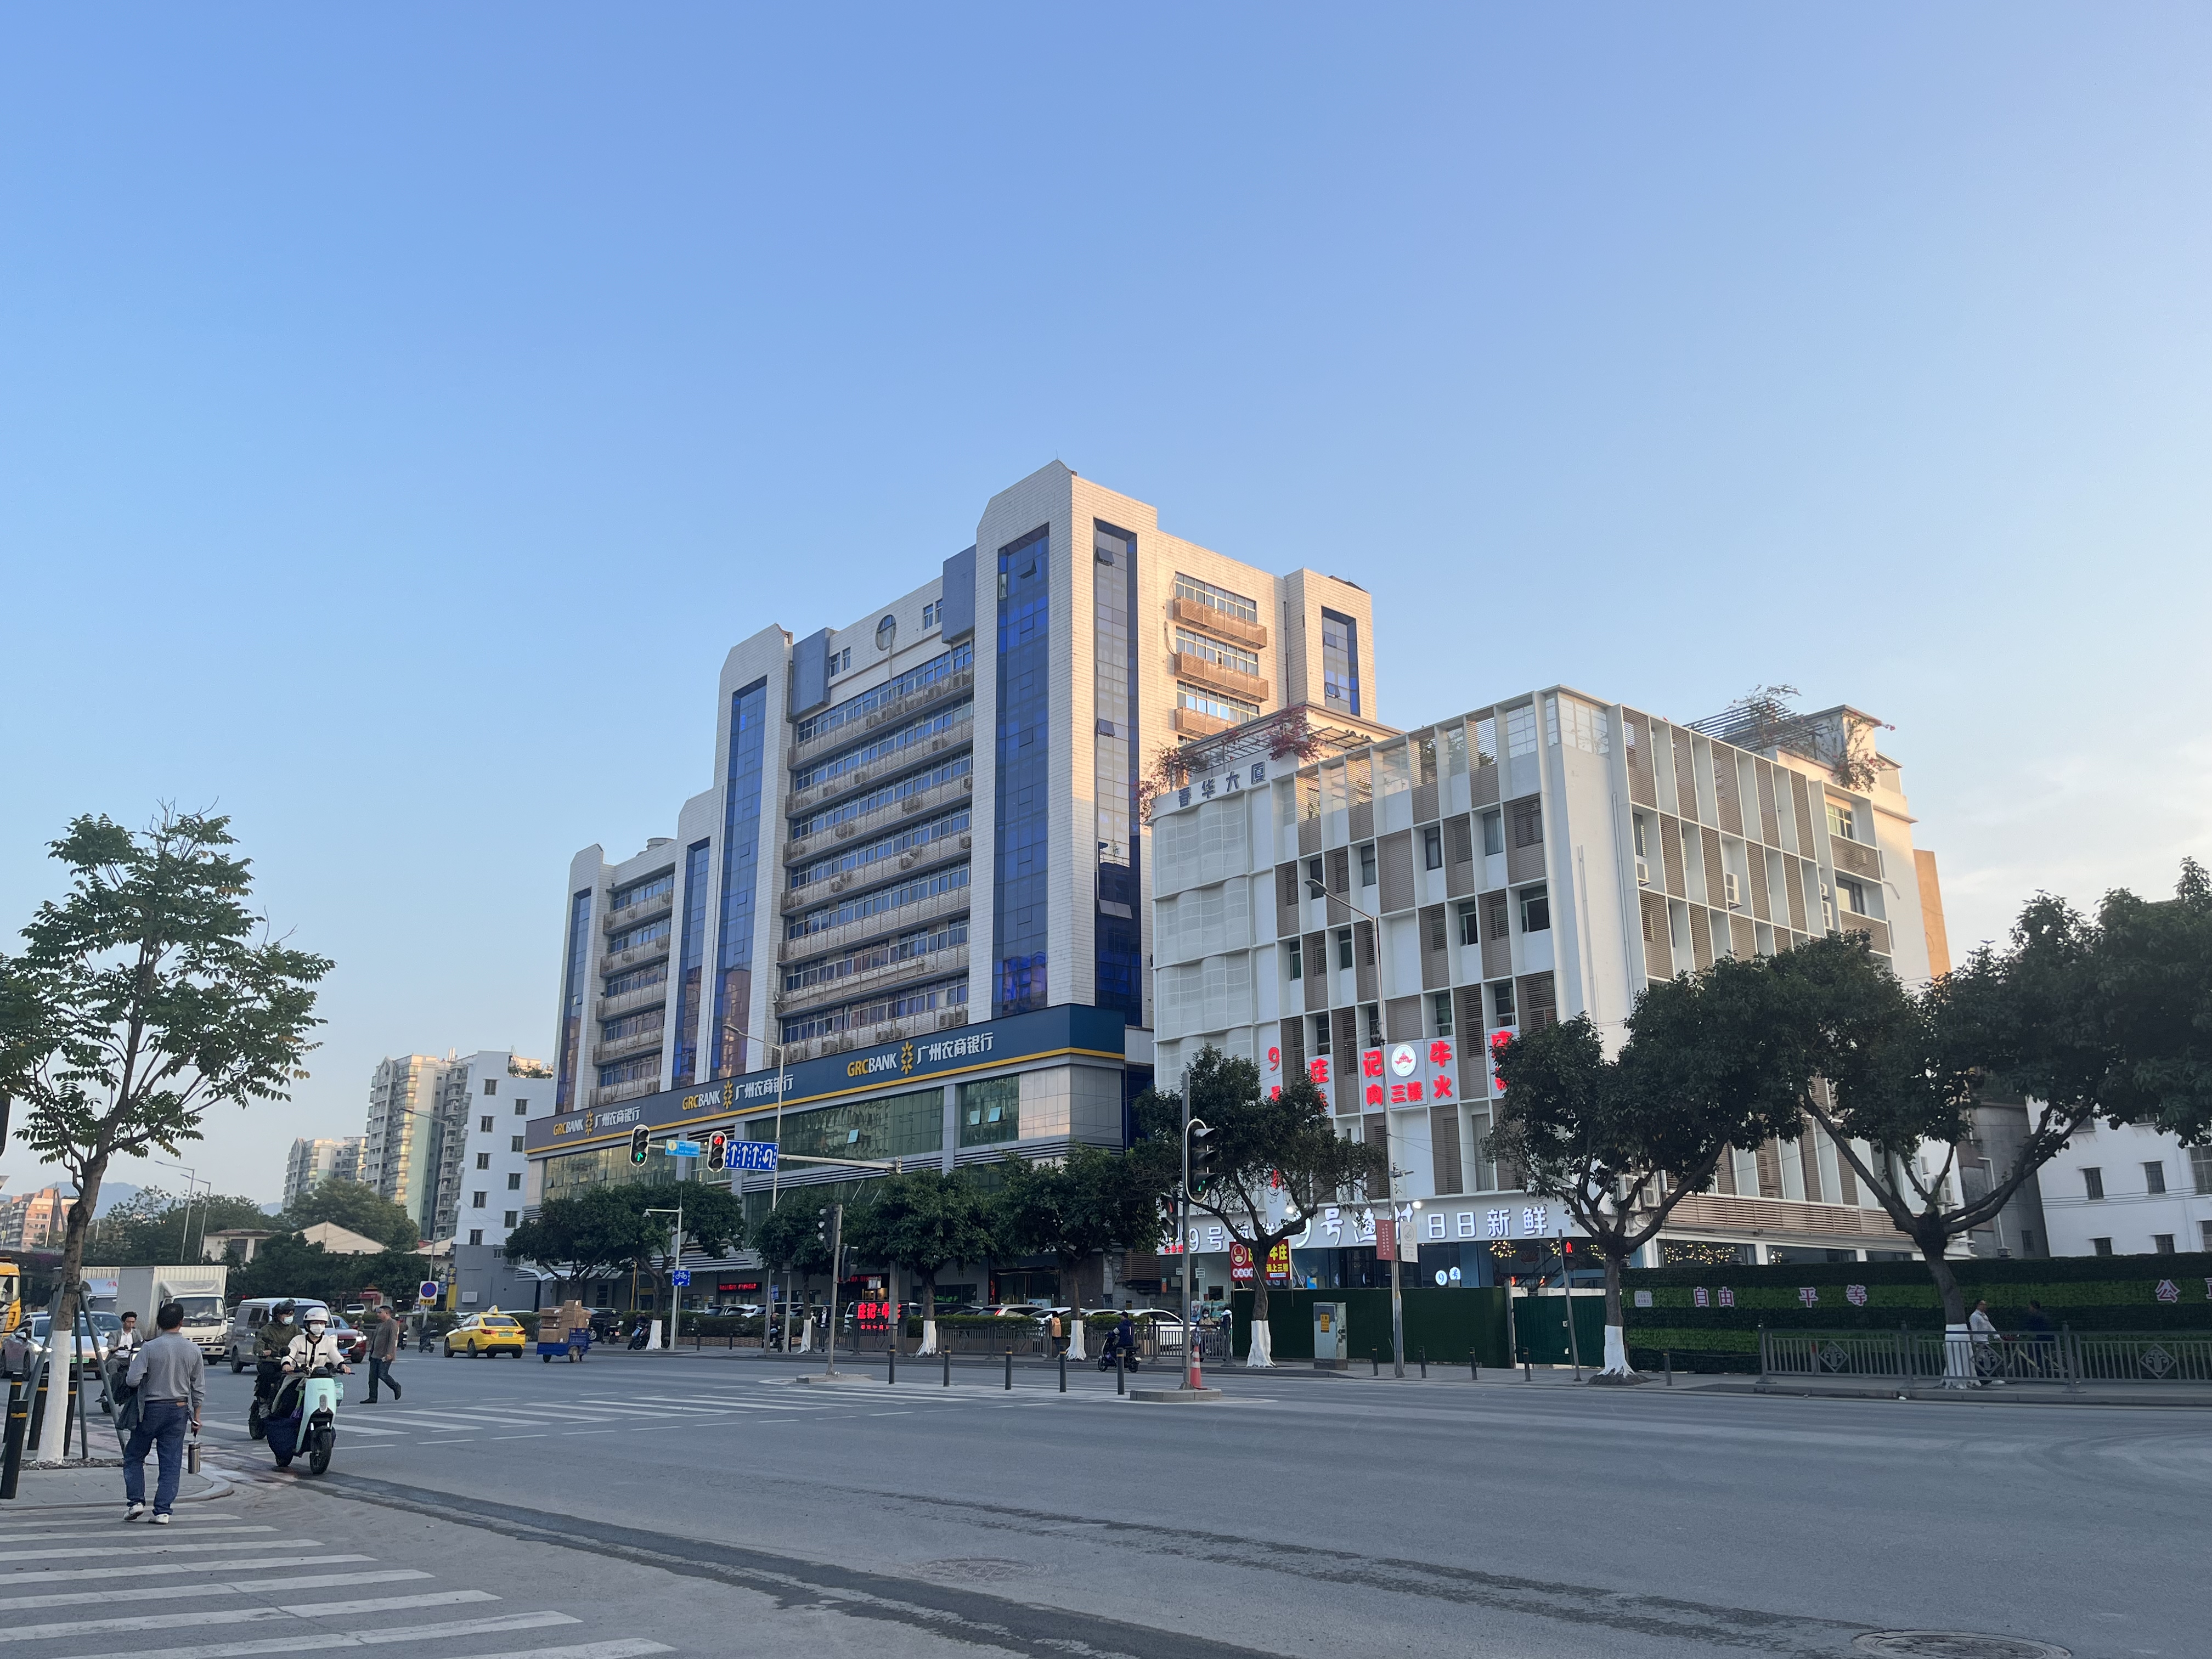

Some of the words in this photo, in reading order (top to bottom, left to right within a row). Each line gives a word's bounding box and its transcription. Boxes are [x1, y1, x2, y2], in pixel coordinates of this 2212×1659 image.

[917, 1032, 994, 1065] 广州农商银行
[847, 1052, 898, 1077] GRCBANK
[735, 1074, 794, 1101] 广州农商银行
[682, 1090, 721, 1111] GRCBANK
[553, 1118, 584, 1136] GRCBANK
[594, 1106, 641, 1129] 广州农商银行
[1427, 1206, 1547, 1240] 日日新鲜
[1693, 1286, 1735, 1307] 自由
[1798, 1284, 1867, 1308] 平等
